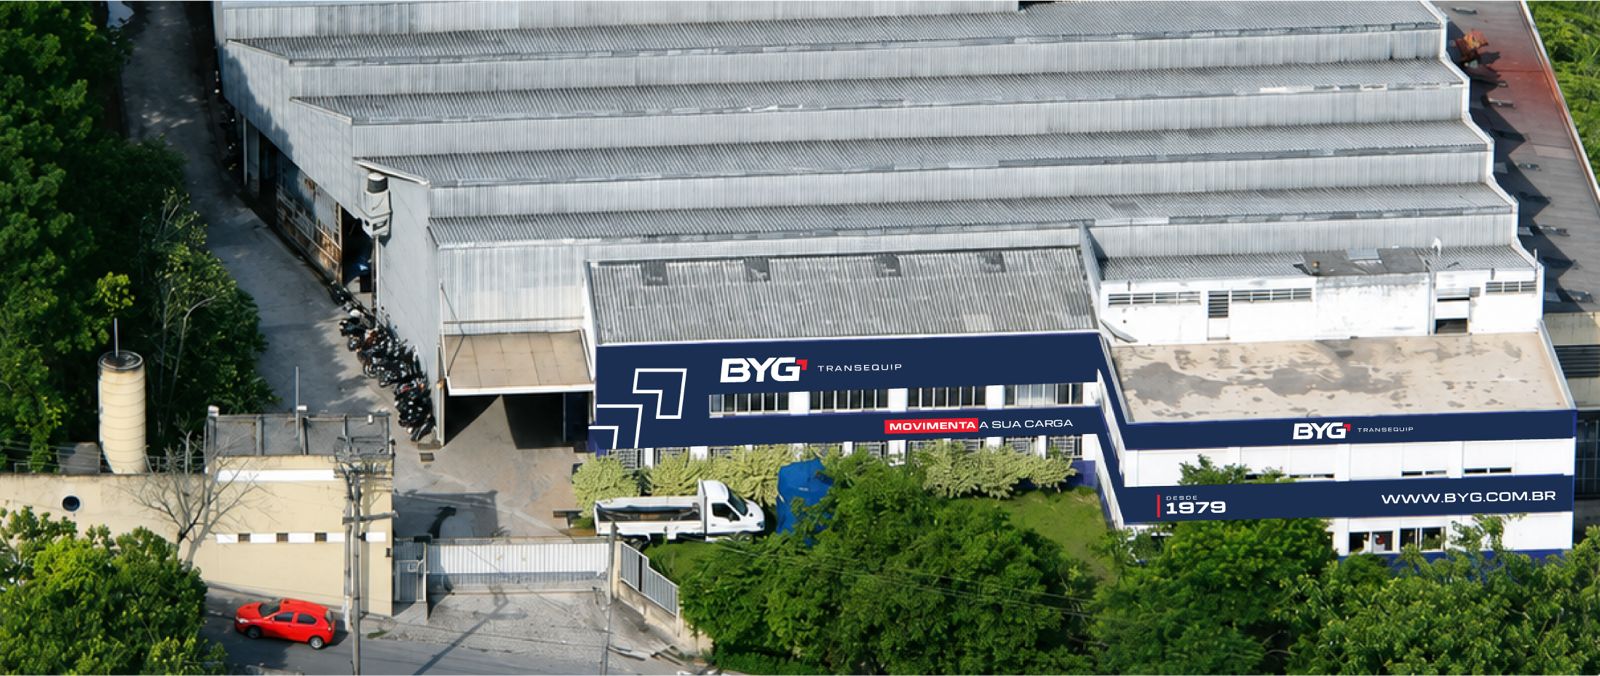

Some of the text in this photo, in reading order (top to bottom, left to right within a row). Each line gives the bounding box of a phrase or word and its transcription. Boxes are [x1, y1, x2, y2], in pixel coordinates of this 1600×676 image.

[719, 356, 902, 384] BYG TRANSEQUIP
[889, 419, 1074, 431] MOVIMENTA A SUA CARGA
[1292, 422, 1347, 440] BYG
[1380, 490, 1557, 505] WWW.BYG.COM.BR
[1166, 500, 1227, 515] 1979
